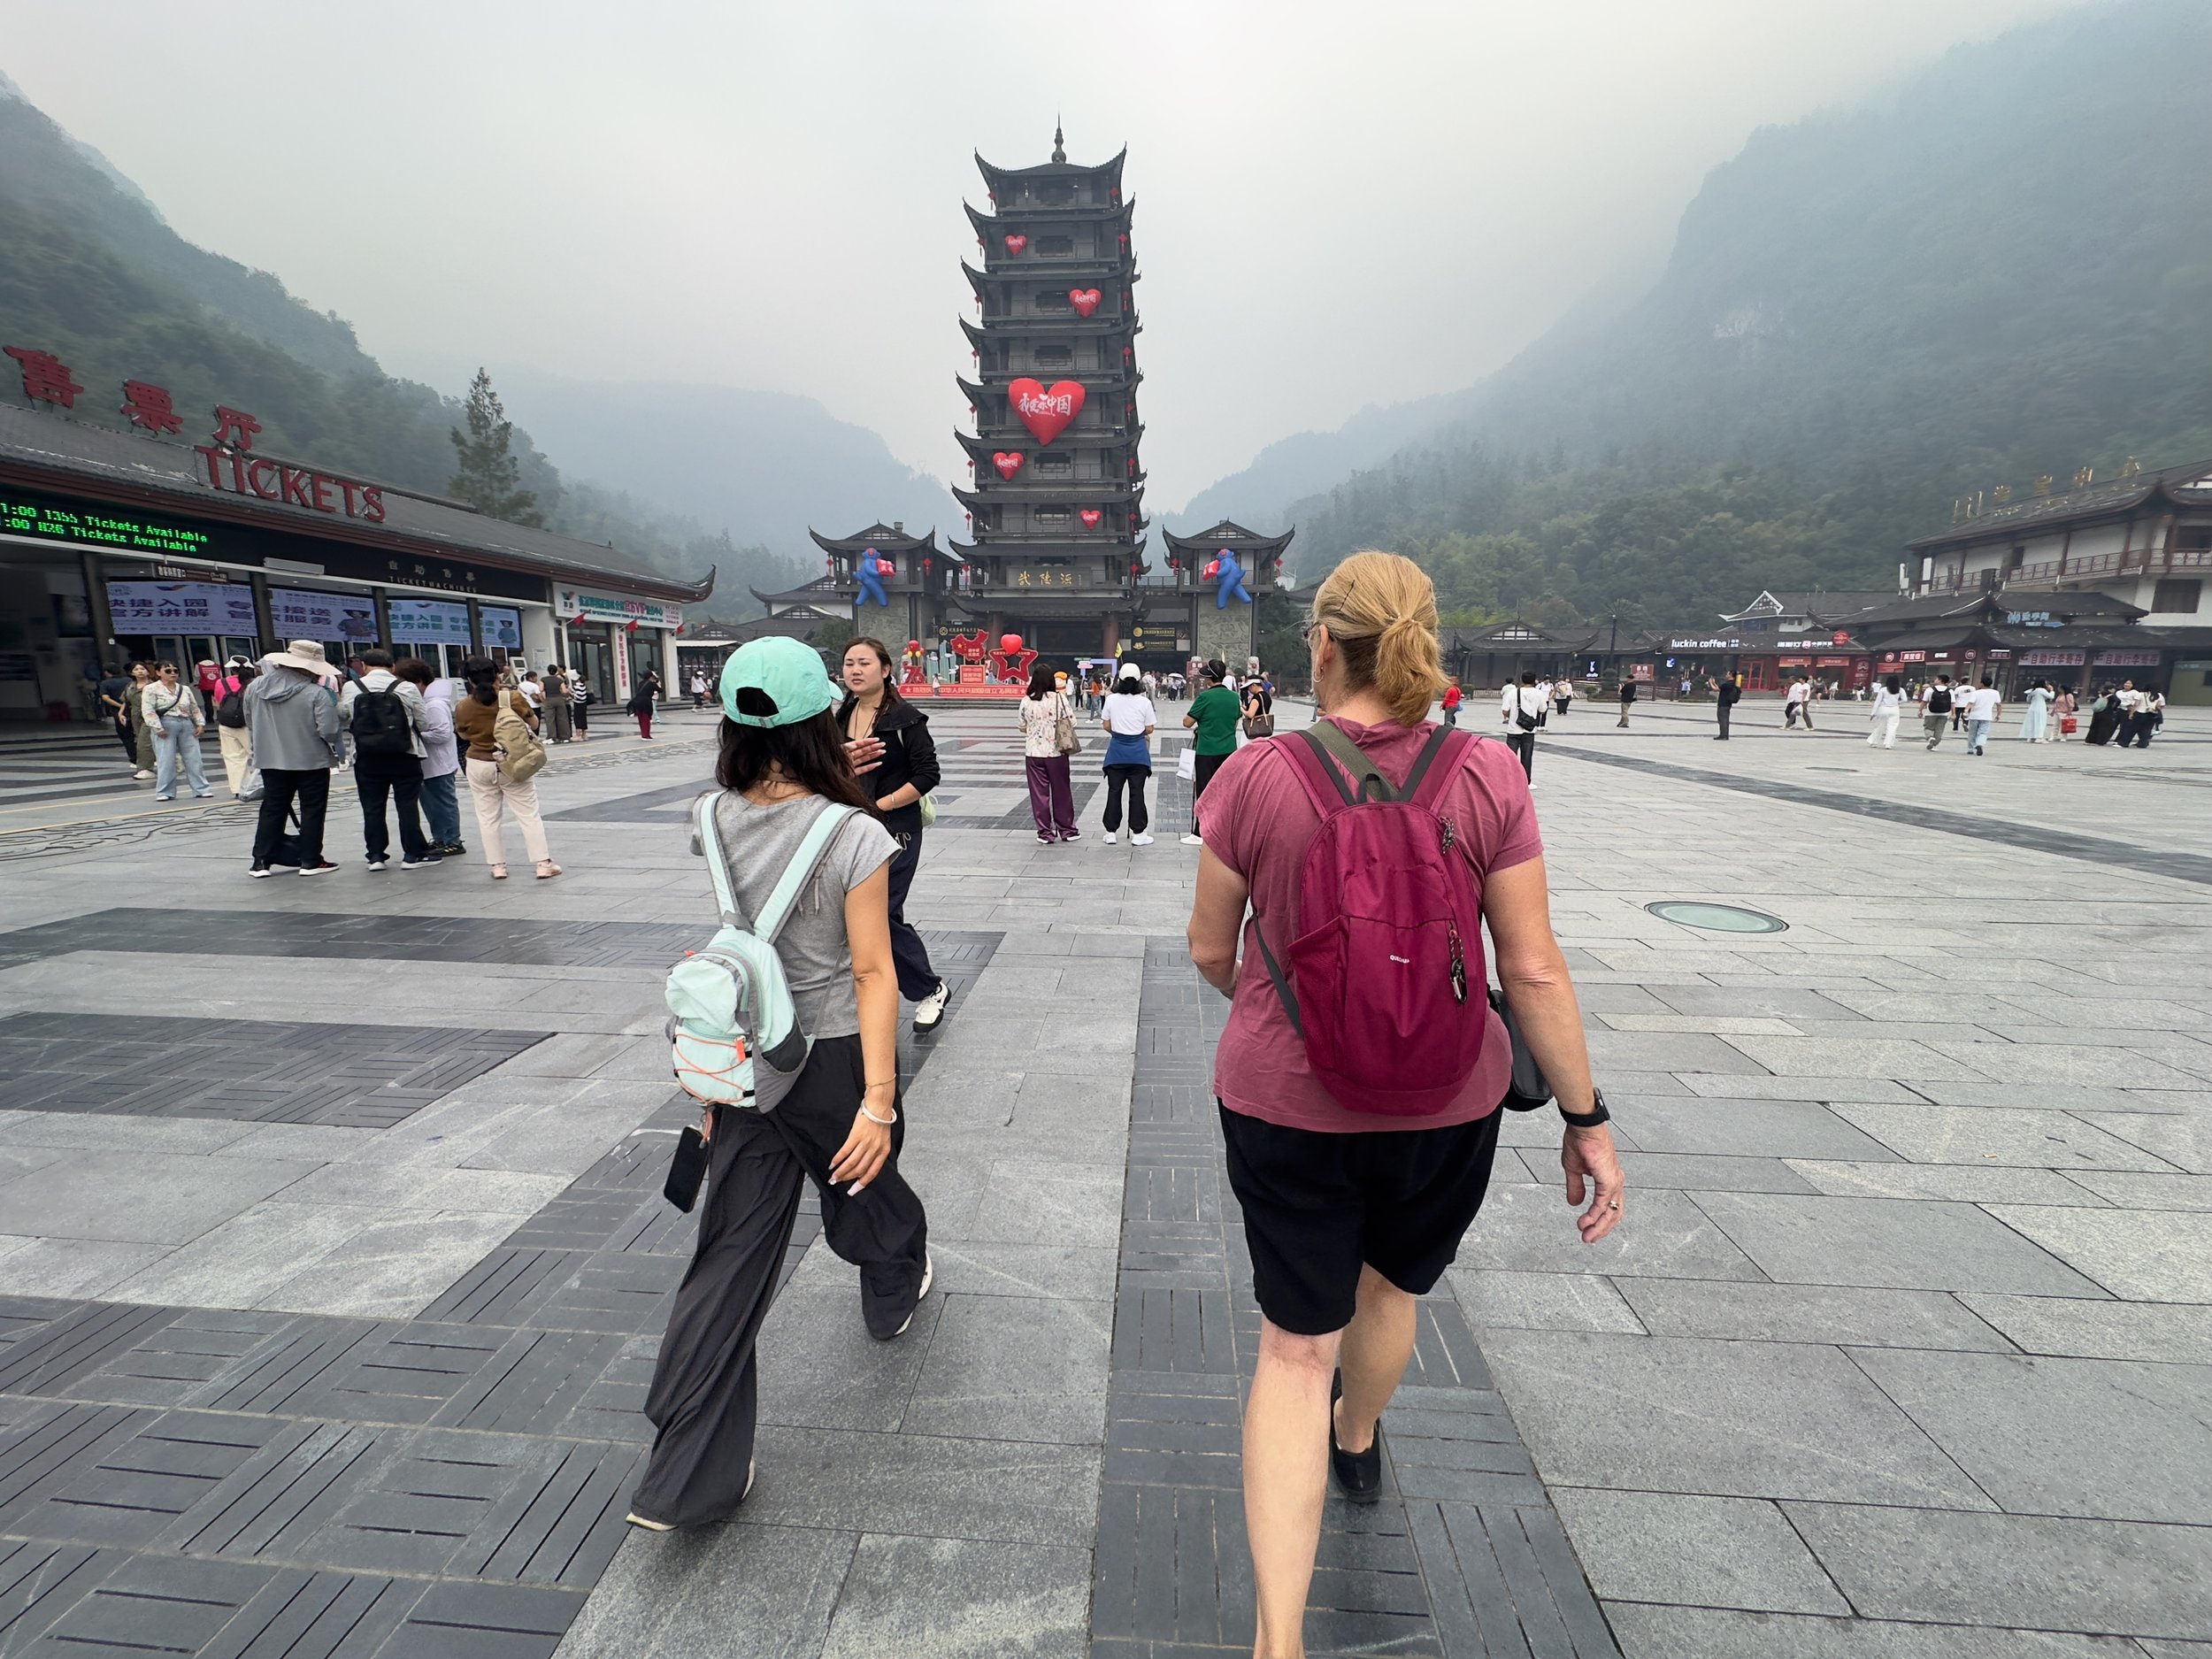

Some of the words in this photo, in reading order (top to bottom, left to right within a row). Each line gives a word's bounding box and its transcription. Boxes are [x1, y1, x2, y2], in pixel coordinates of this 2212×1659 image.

[3, 344, 262, 451] 售票厅
[193, 445, 386, 522] TICKETS
[71, 526, 127, 543] Tickets
[134, 535, 197, 553] Available
[85, 516, 140, 533] Tickets
[146, 525, 208, 543] Available
[1671, 639, 1697, 648] luckin
[1699, 639, 1727, 648] coffee
